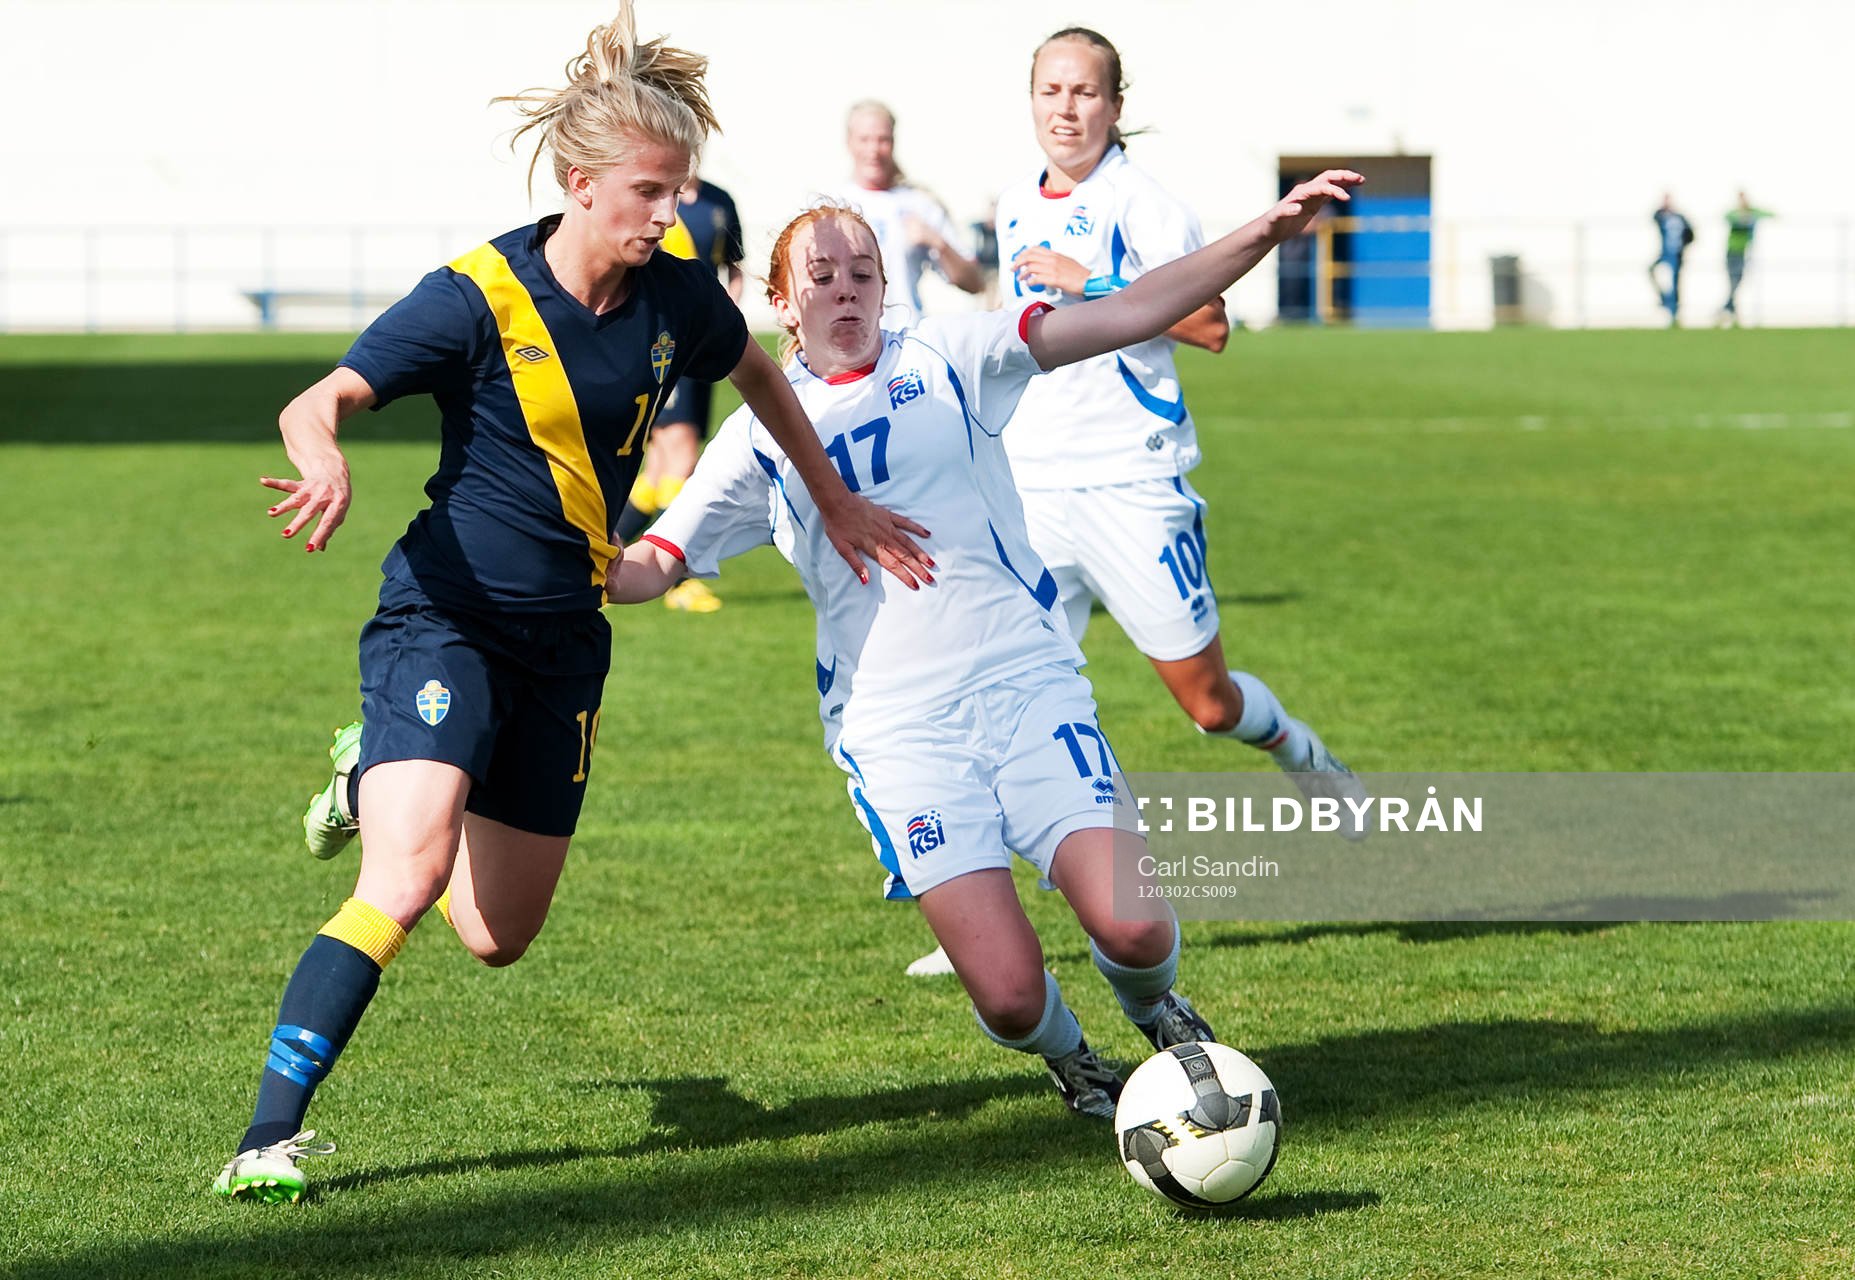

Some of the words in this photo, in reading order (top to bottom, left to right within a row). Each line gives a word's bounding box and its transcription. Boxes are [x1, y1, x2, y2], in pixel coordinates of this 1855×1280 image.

[824, 416, 891, 493] 17
[1159, 530, 1201, 600] 10
[1052, 722, 1112, 778] 17
